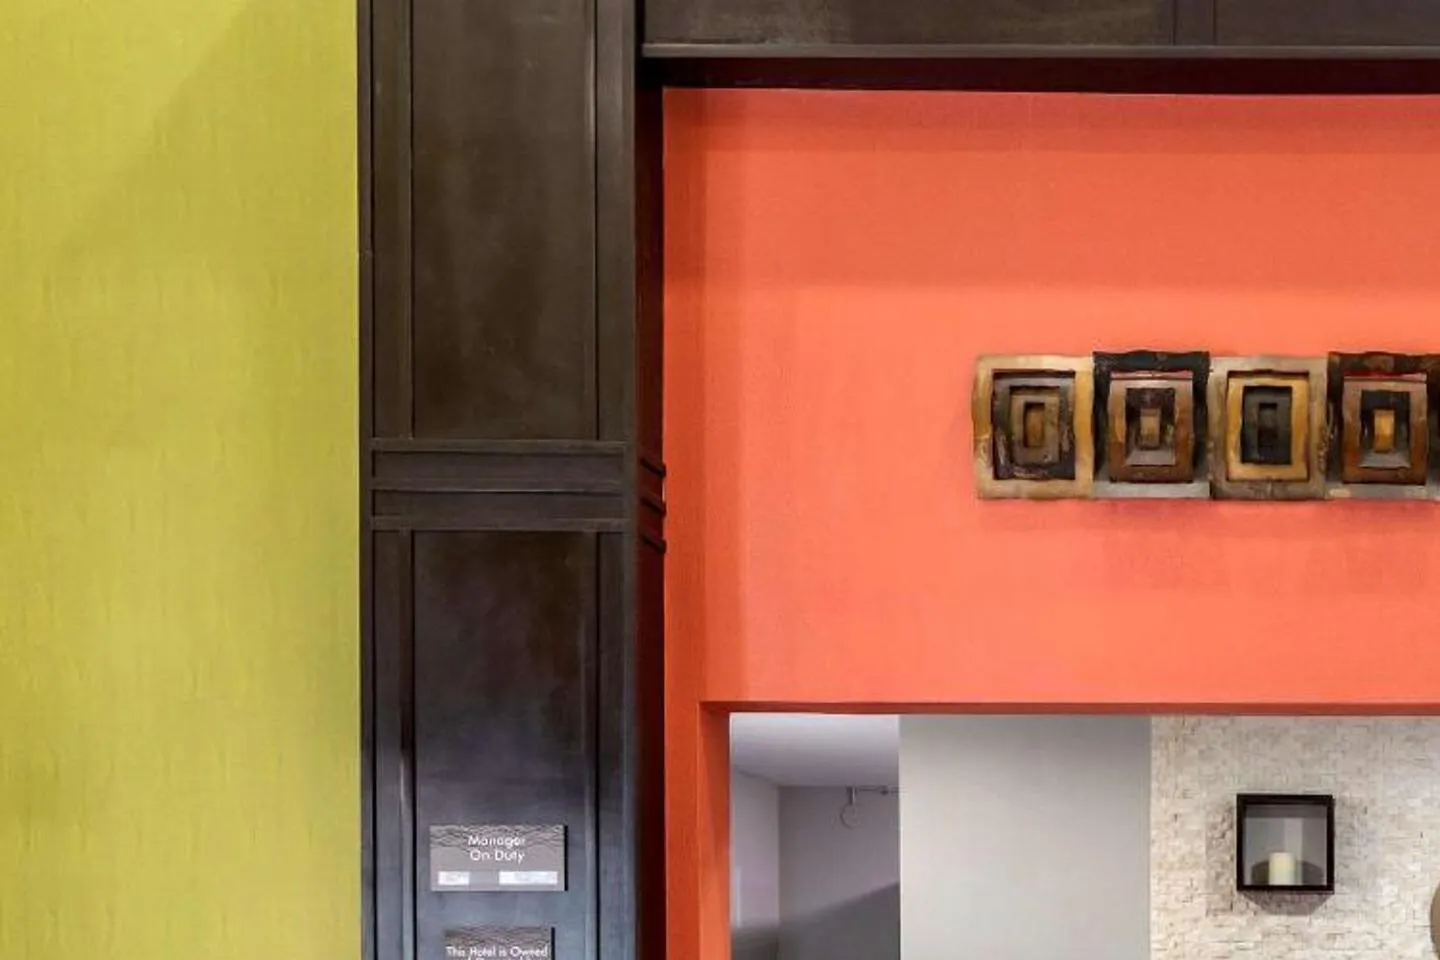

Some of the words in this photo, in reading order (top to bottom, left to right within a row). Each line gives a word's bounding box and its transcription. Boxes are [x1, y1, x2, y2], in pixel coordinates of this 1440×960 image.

[468, 835, 525, 848] Manager
[470, 849, 490, 861] On
[495, 849, 525, 864] Duty
[446, 946, 466, 956] This
[470, 946, 496, 956] Hotel
[499, 946, 507, 956] is
[510, 946, 548, 956] Owned
